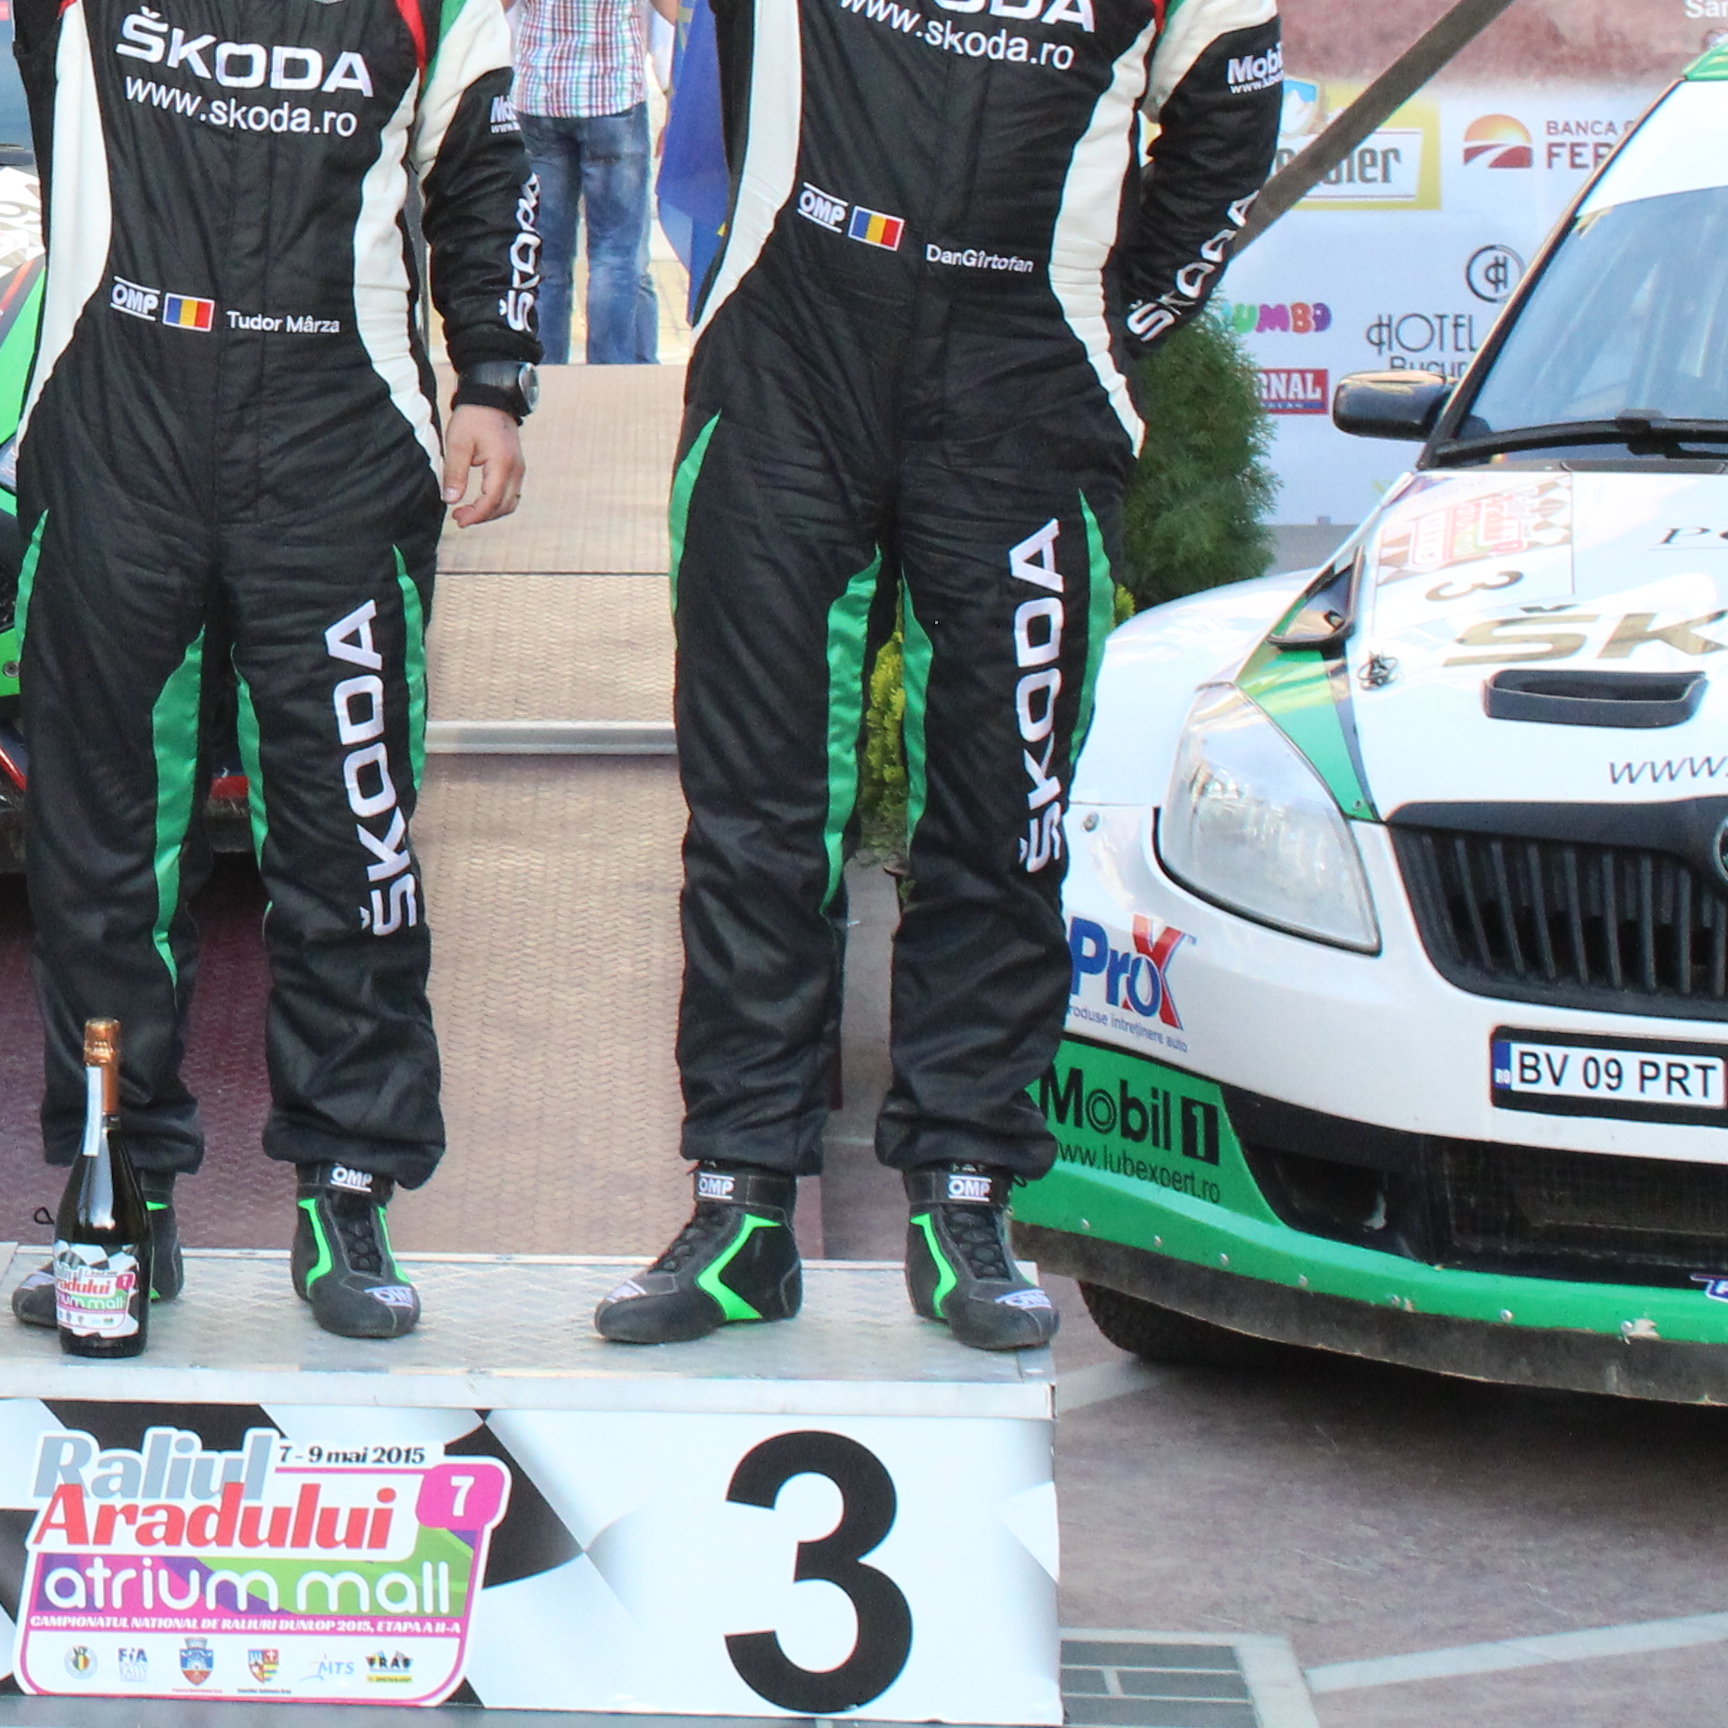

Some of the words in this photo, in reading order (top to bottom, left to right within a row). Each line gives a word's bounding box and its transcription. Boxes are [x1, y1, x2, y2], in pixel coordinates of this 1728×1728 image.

[115, 6, 373, 98] ŠKODA
[126, 76, 357, 137] www.skoda.ro
[1546, 120, 1618, 136] BANCA
[798, 189, 847, 226] OMP
[1126, 189, 1260, 342] ŠKODA
[111, 282, 159, 315] OMP
[227, 311, 282, 333] Tudor
[286, 314, 341, 334] Mârza
[1425, 570, 1525, 602] 3
[1009, 518, 1065, 872] ŠKODA
[325, 598, 419, 937] ŠKODA
[1166, 1035, 1189, 1053] auto
[1495, 1068, 1512, 1085] RO
[1519, 1050, 1569, 1087] BV
[1583, 1056, 1623, 1091] 09
[1639, 1060, 1718, 1099] PRT
[1039, 1063, 1172, 1151] Mobil
[332, 1166, 374, 1187] OMP
[698, 1177, 735, 1196] OMP
[948, 1179, 991, 1197] OMP
[88, 1296, 123, 1310] mall
[33, 1433, 277, 1500] Raliul
[280, 1446, 292, 1463] 7
[309, 1446, 322, 1463] 9
[327, 1446, 368, 1463] mai
[372, 1447, 425, 1464] 2015
[33, 1481, 397, 1549] Aradului
[451, 1476, 474, 1517] 7
[45, 1557, 278, 1612] atrium
[297, 1561, 449, 1613] mall
[724, 1430, 914, 1715] 3
[30, 1615, 129, 1628] CAMPIONATUL
[131, 1617, 199, 1629] NATIONAL
[200, 1619, 220, 1630] DE
[221, 1619, 277, 1631] RALIURI
[279, 1619, 336, 1631] DUNLOP
[337, 1620, 375, 1633] 2015,
[376, 1621, 422, 1633] ETAPA
[422, 1622, 433, 1633] A
[435, 1622, 461, 1634] II-A
[317, 1661, 354, 1676] MTS
